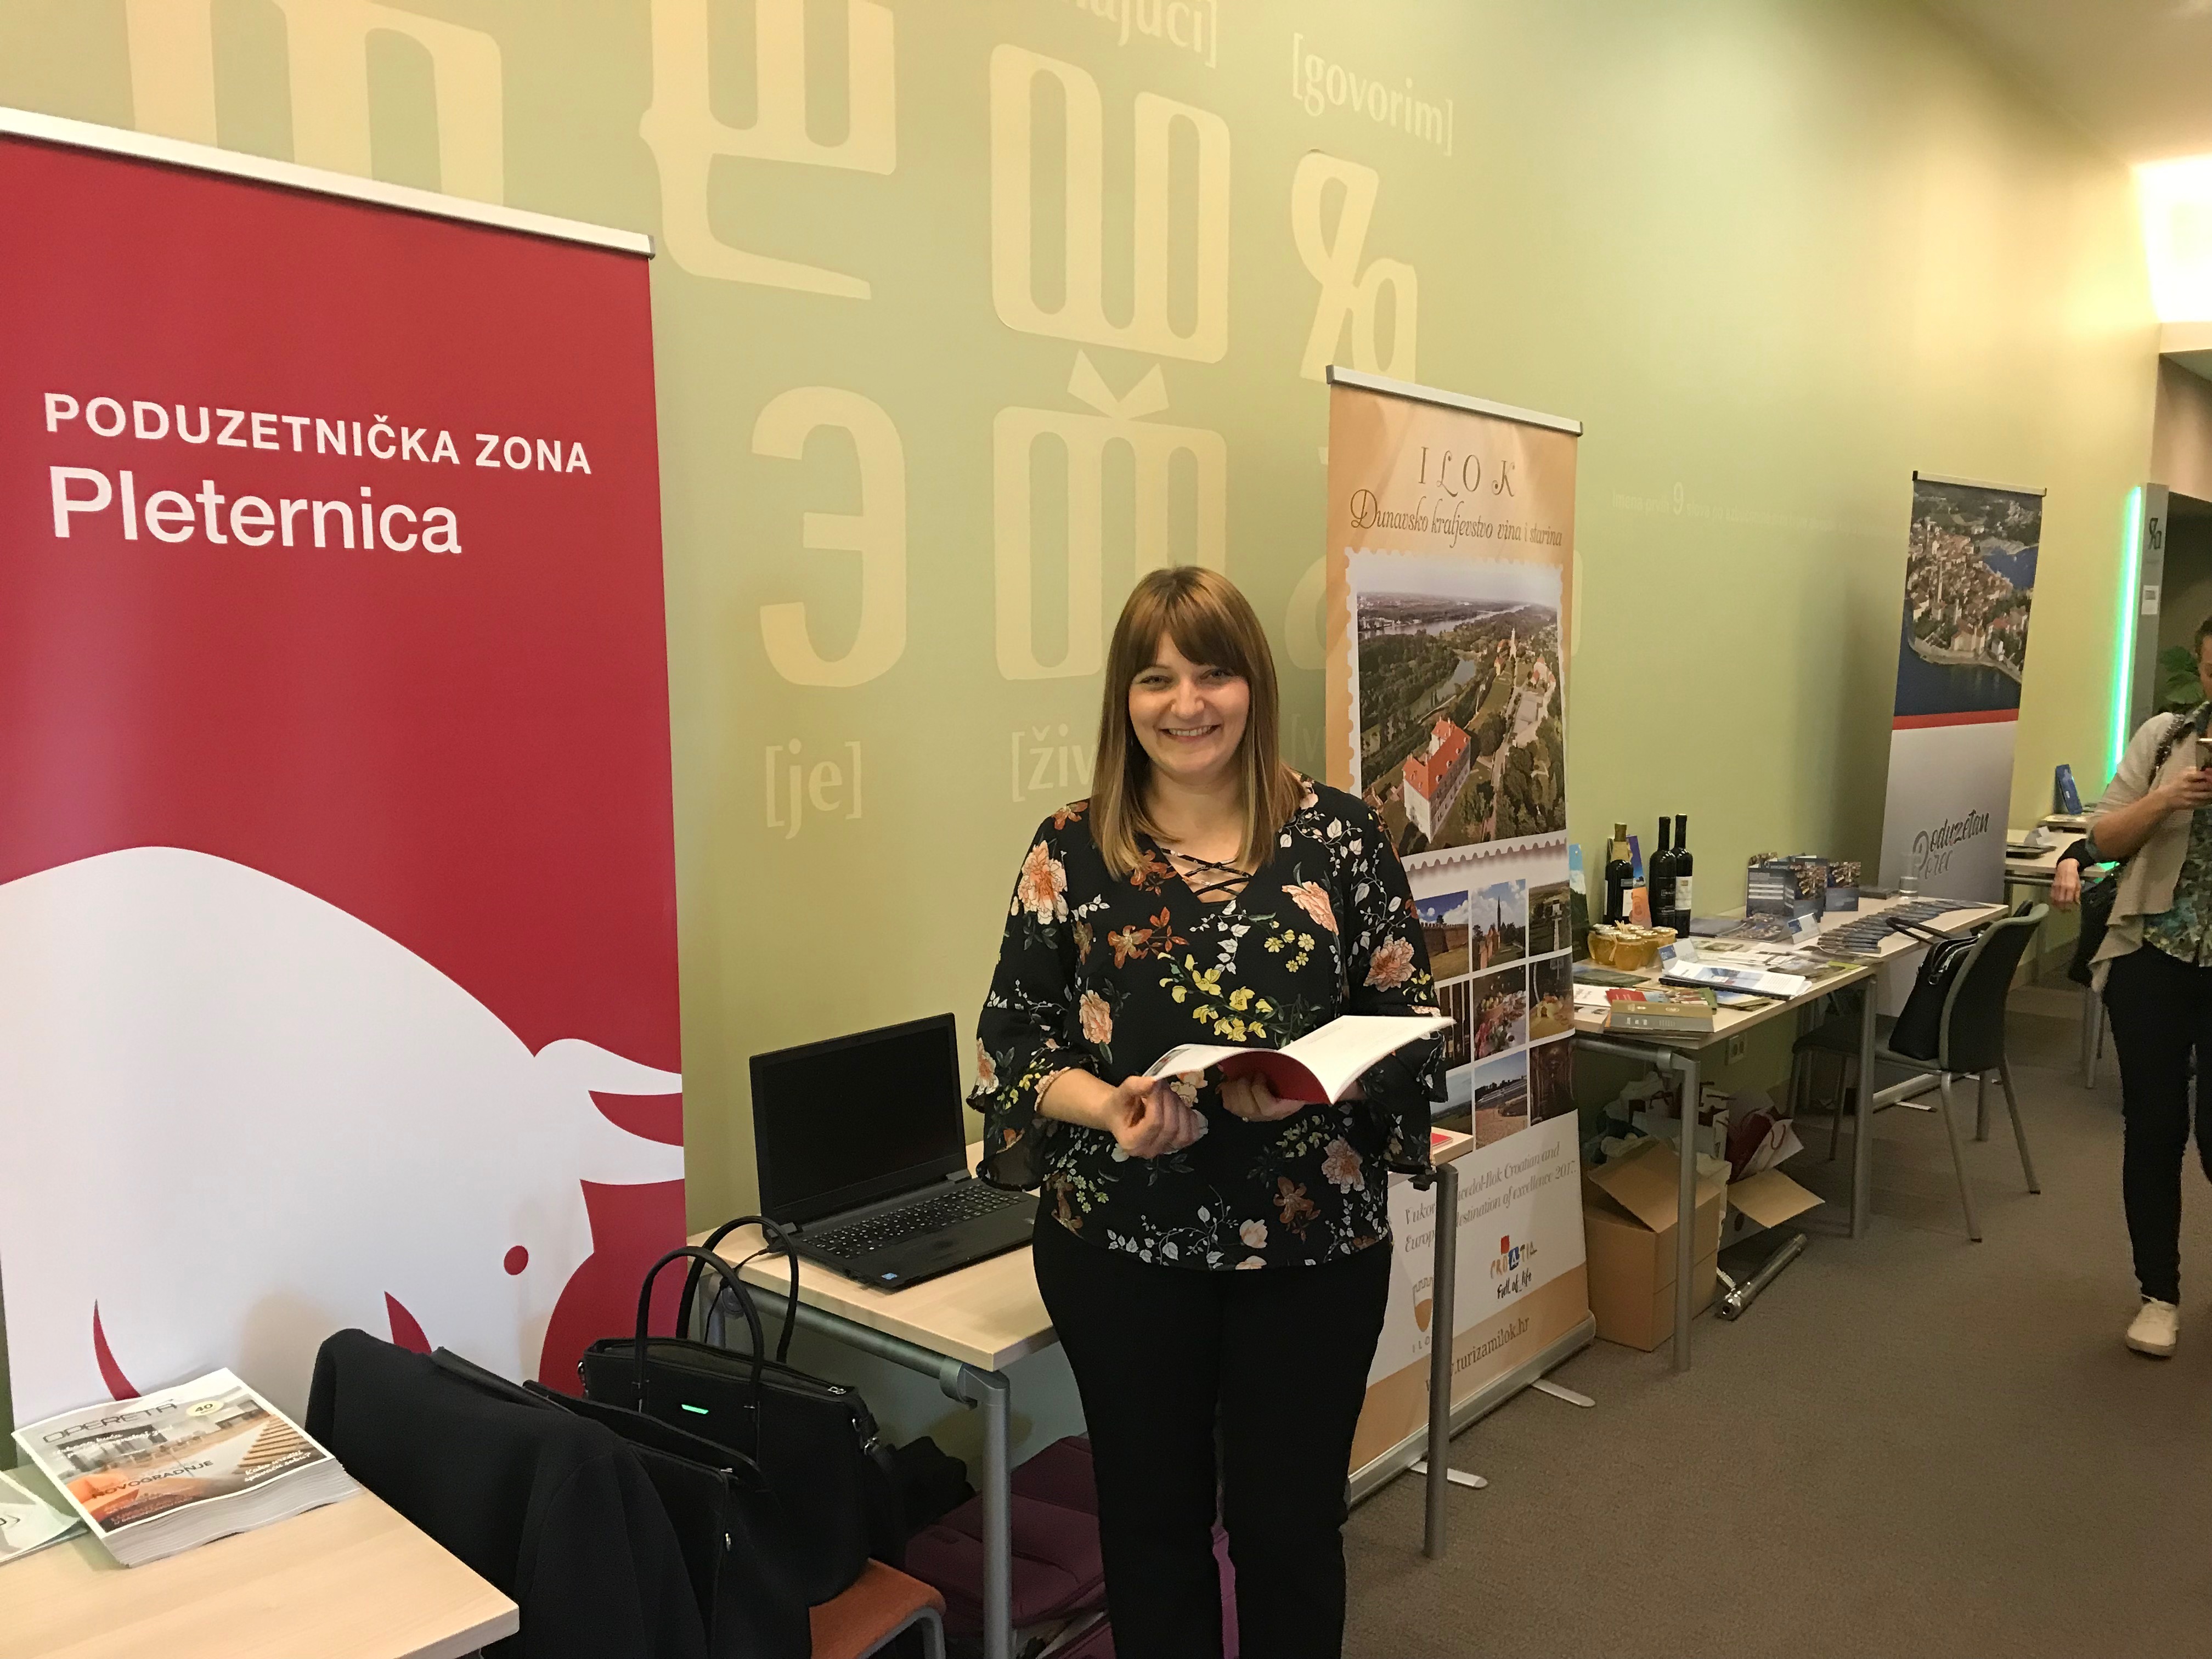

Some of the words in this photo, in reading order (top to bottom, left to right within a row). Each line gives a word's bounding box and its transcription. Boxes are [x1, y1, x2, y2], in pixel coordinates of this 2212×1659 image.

[44, 392, 460, 465] PODUZETNIČKA
[475, 433, 591, 475] ZONA
[49, 466, 462, 554] Pleternica
[1350, 489, 1429, 532] Dunavsko
[1431, 498, 1493, 548] kraljevstvo
[1497, 520, 1521, 541] vina
[1530, 524, 1563, 546] starina
[1673, 481, 1684, 516] 9
[1012, 723, 1097, 802] [živ
[1541, 1141, 1560, 1162] and
